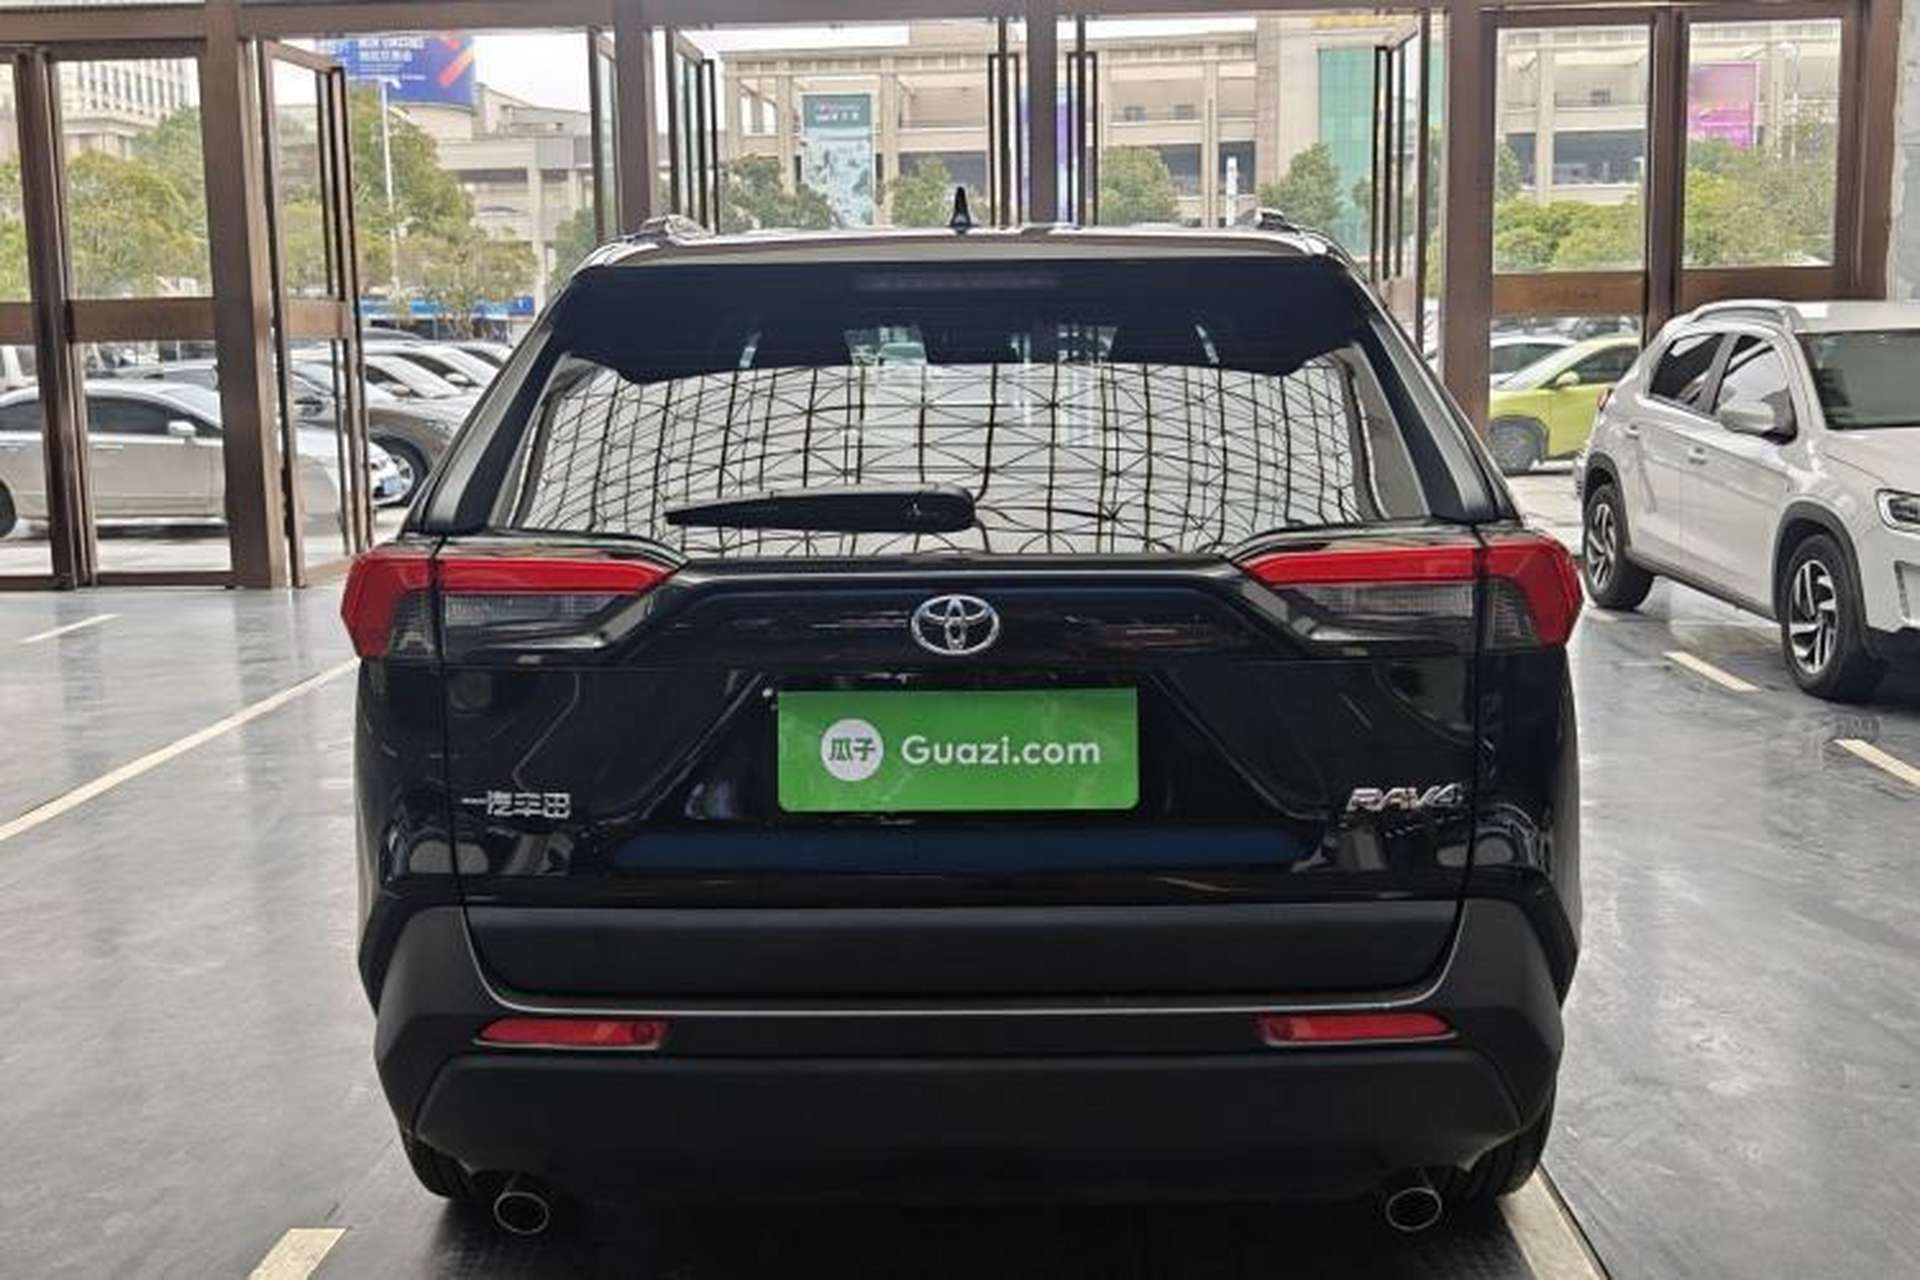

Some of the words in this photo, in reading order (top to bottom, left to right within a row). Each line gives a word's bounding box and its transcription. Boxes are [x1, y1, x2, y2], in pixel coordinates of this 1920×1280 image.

[829, 737, 876, 761] 瓜子
[901, 734, 1100, 765] Guazi.com
[1346, 782, 1464, 812] RAV4
